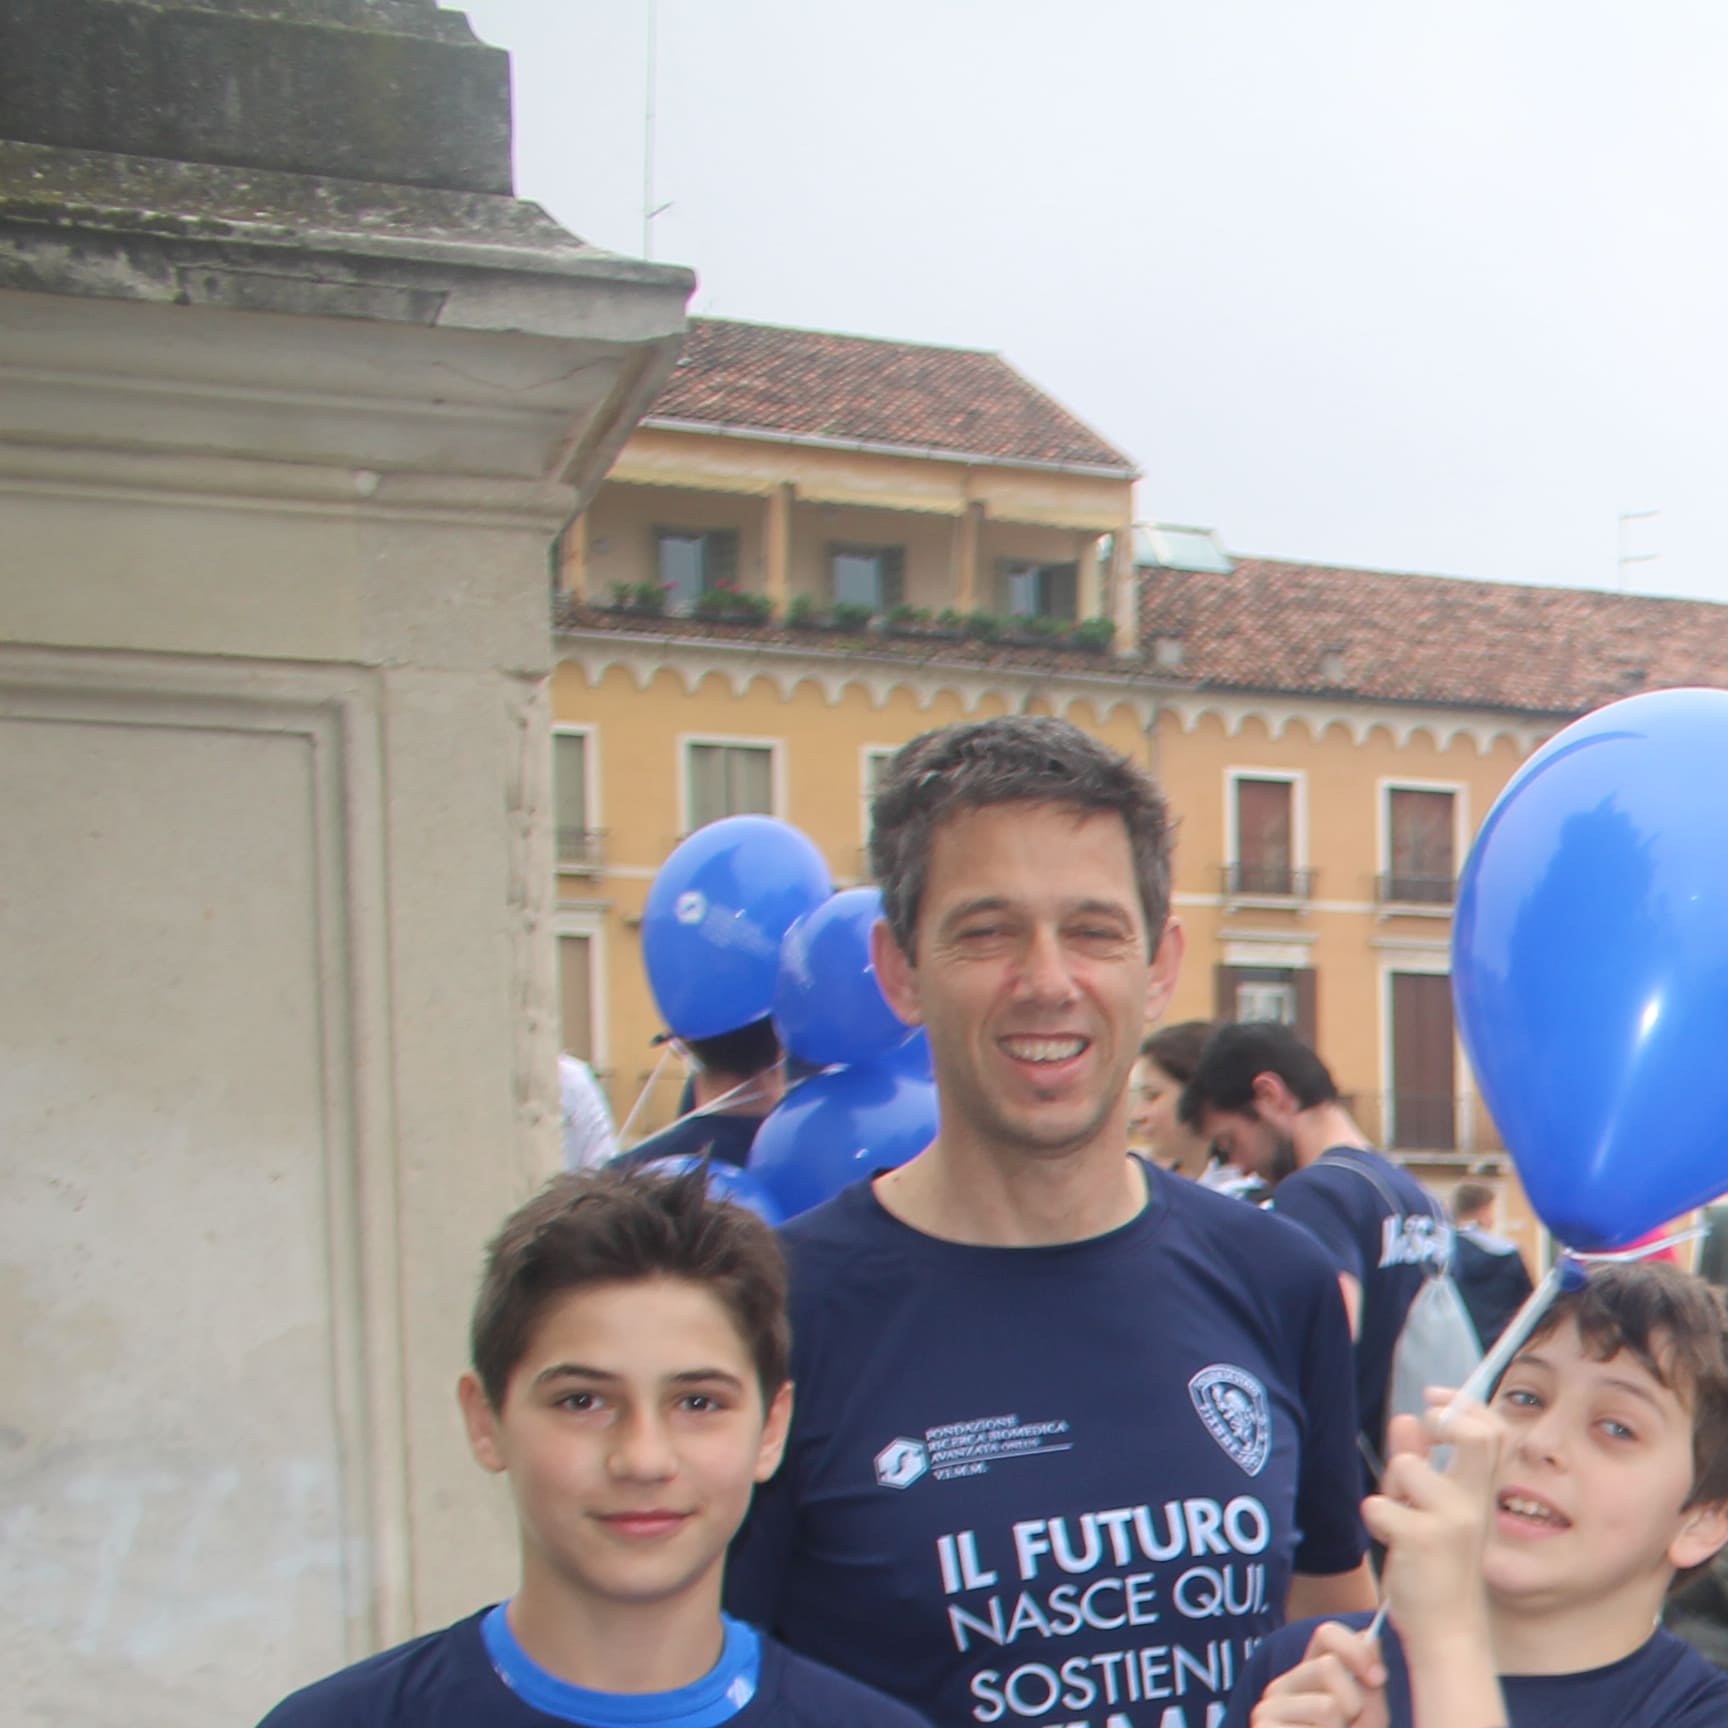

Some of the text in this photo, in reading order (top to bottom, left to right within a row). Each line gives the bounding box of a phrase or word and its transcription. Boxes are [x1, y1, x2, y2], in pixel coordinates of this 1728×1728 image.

[937, 1495, 1271, 1594] IL FUTURO
[948, 1571, 1159, 1652] NASCE
[970, 1638, 1233, 1723] SOSTIENI
